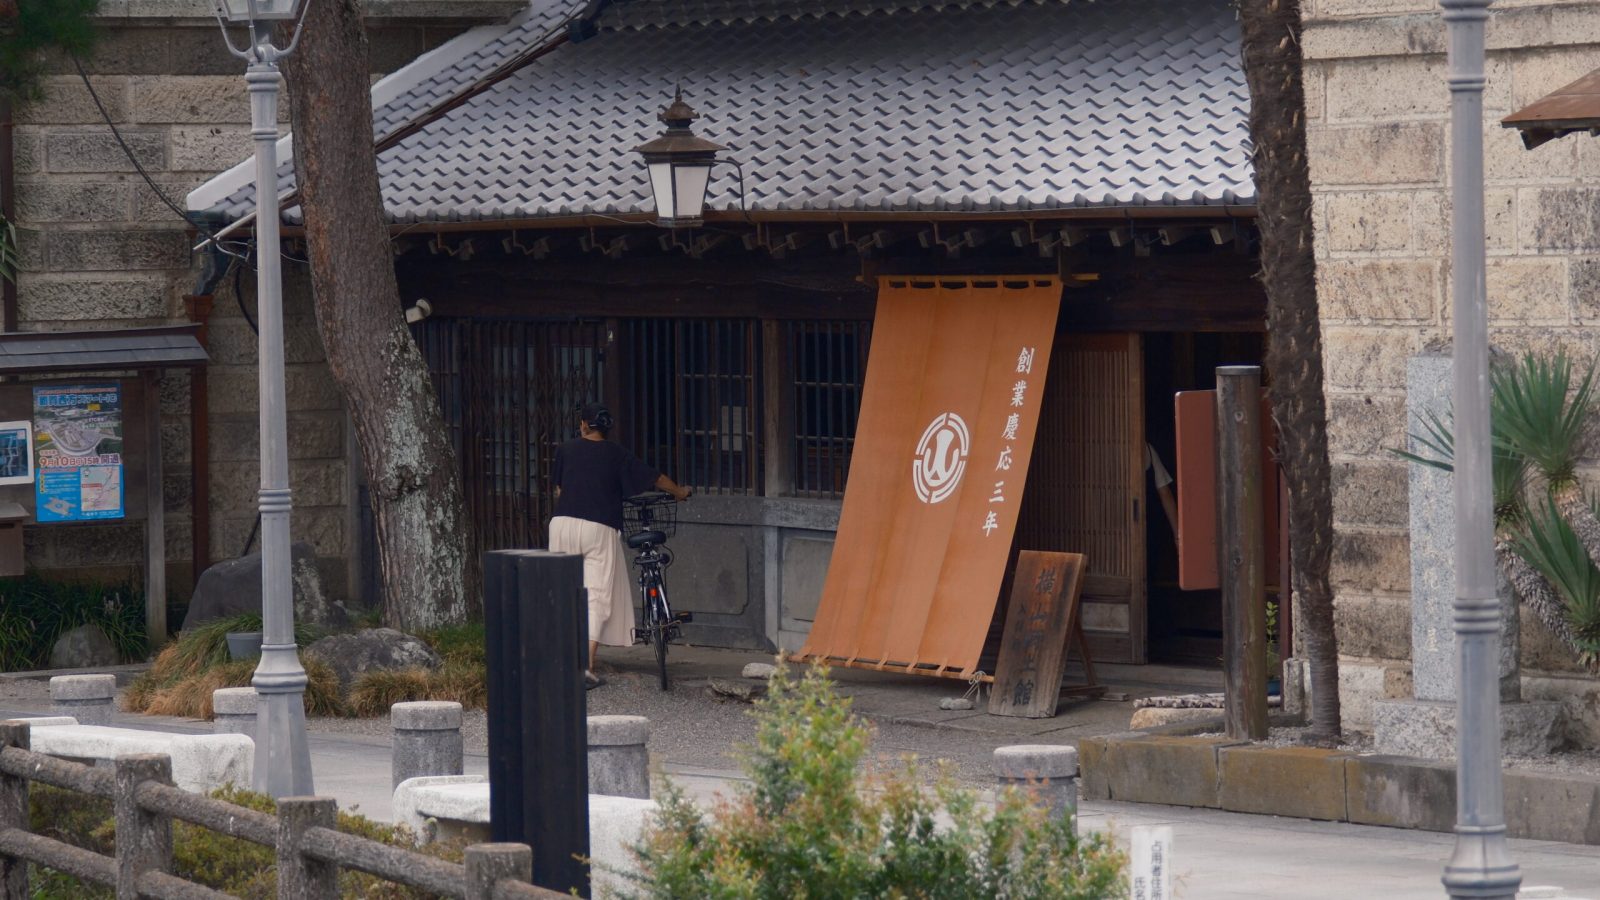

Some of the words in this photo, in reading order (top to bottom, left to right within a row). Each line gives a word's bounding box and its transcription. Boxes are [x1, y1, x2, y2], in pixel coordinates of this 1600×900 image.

[982, 346, 1036, 537] 創業慶応三年
